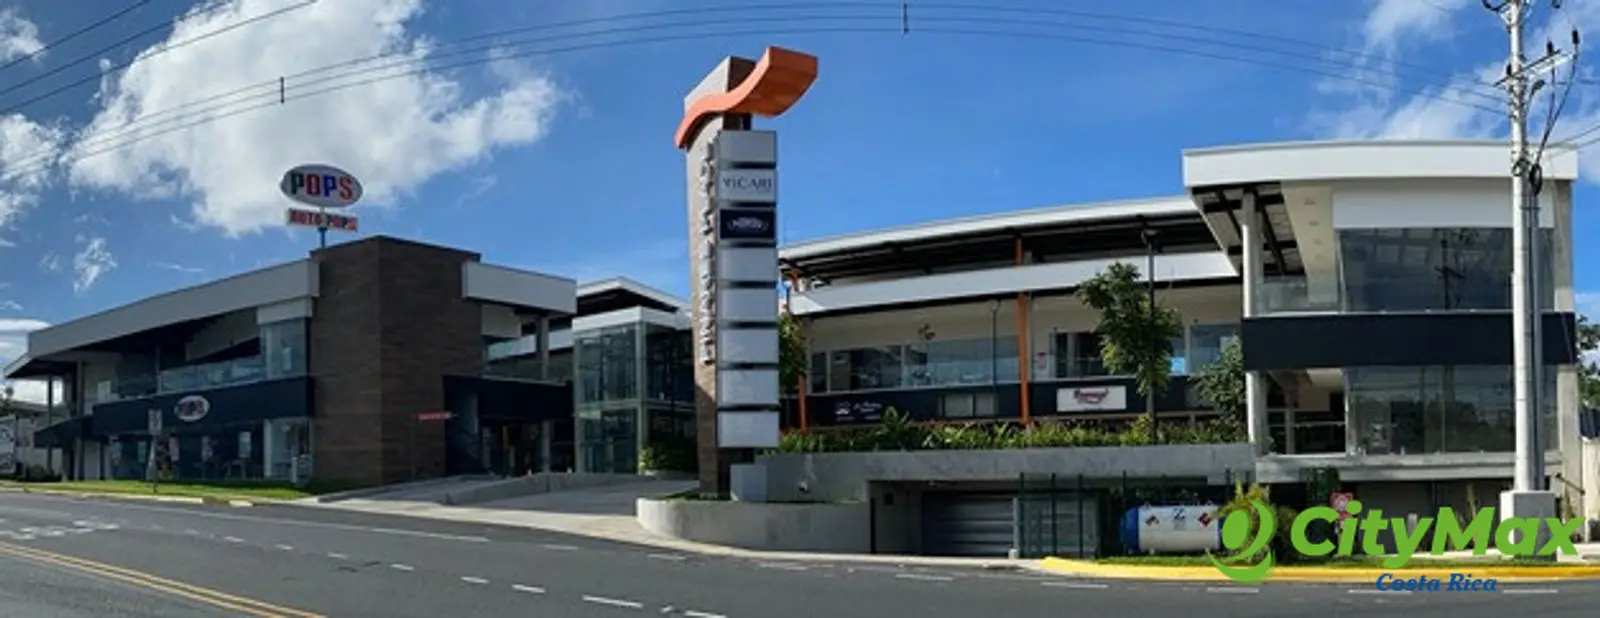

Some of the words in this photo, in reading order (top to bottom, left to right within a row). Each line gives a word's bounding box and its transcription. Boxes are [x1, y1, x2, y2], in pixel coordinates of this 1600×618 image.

[291, 173, 353, 200] POPS
[290, 210, 323, 224] AUTO
[326, 215, 356, 230] POPS
